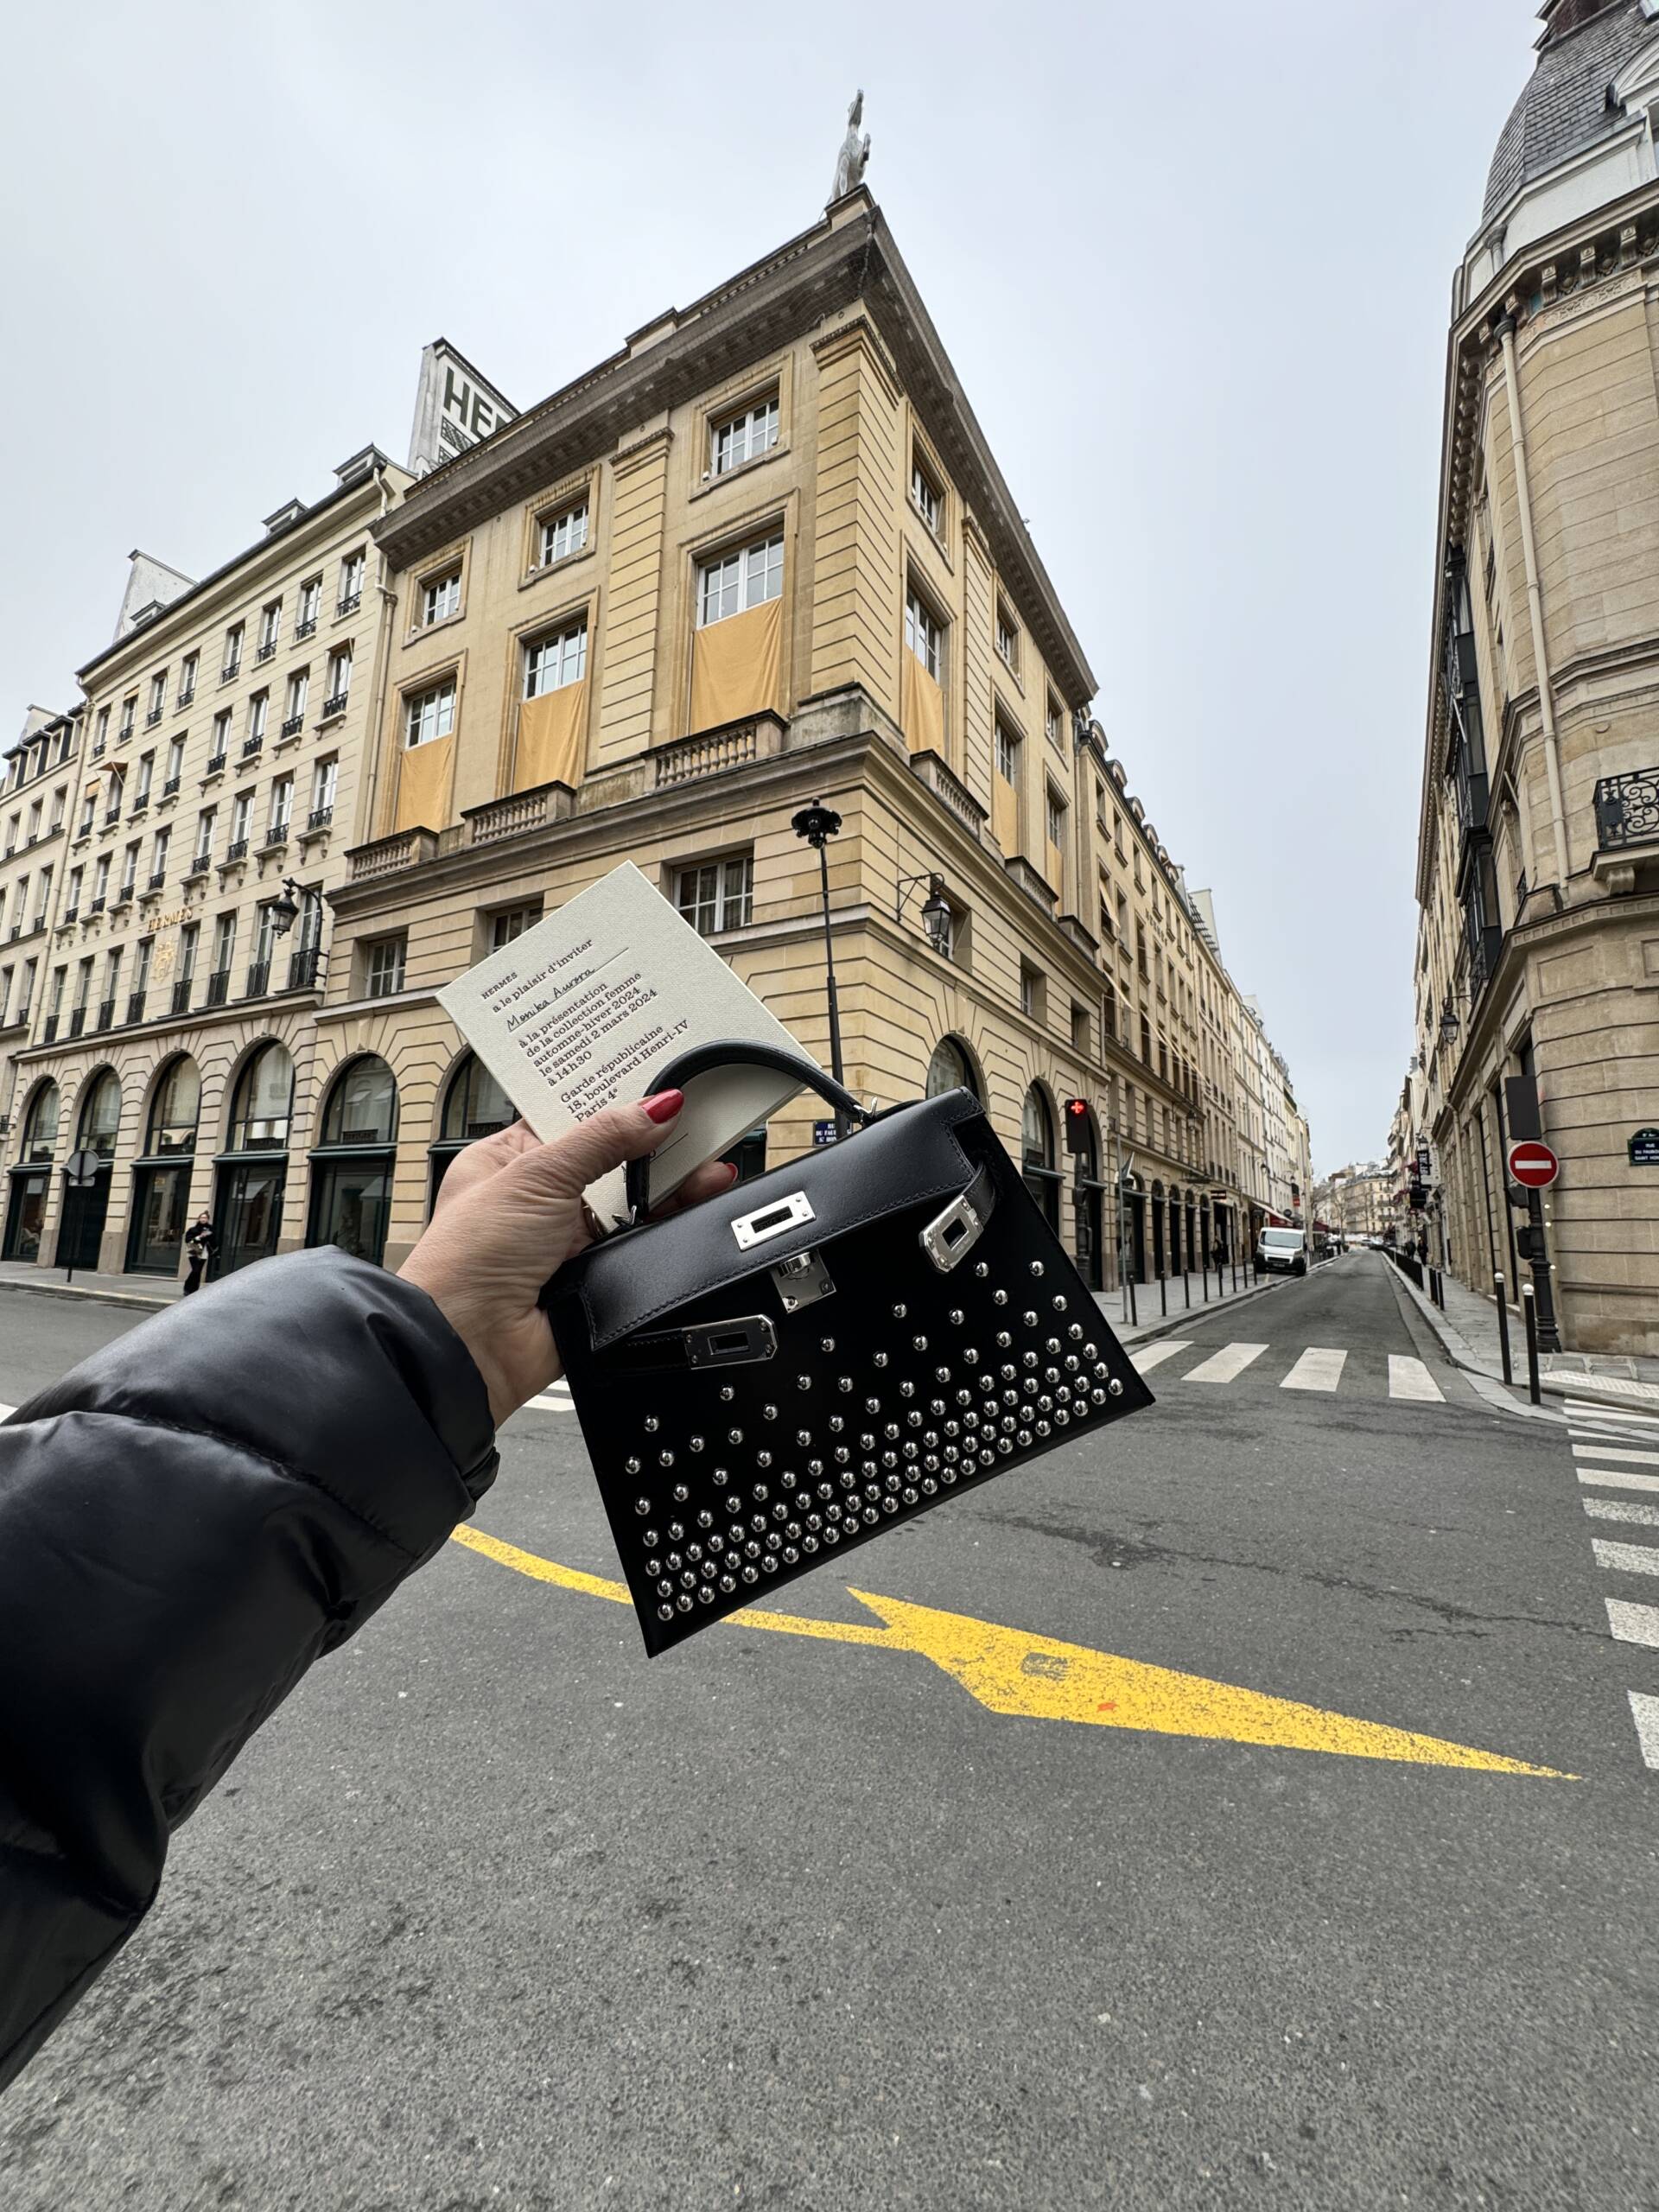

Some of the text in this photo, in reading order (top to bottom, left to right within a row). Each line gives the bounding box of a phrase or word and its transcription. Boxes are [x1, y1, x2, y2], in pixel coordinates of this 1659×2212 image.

[493, 939, 594, 1014] a le plaisir d'inviter
[505, 969, 596, 1033] Monika Aurora
[518, 982, 608, 1049] à la présentation
[526, 972, 642, 1058] de la collection femme
[533, 986, 641, 1068] automne-hiver 2024
[538, 988, 658, 1078] le samedi 2 mars 2024
[547, 1077, 557, 1087] à
[561, 1026, 664, 1104] Garde républicaine
[567, 1019, 689, 1115] 18, boulevard Henri-IV
[575, 1098, 608, 1123] Paris
